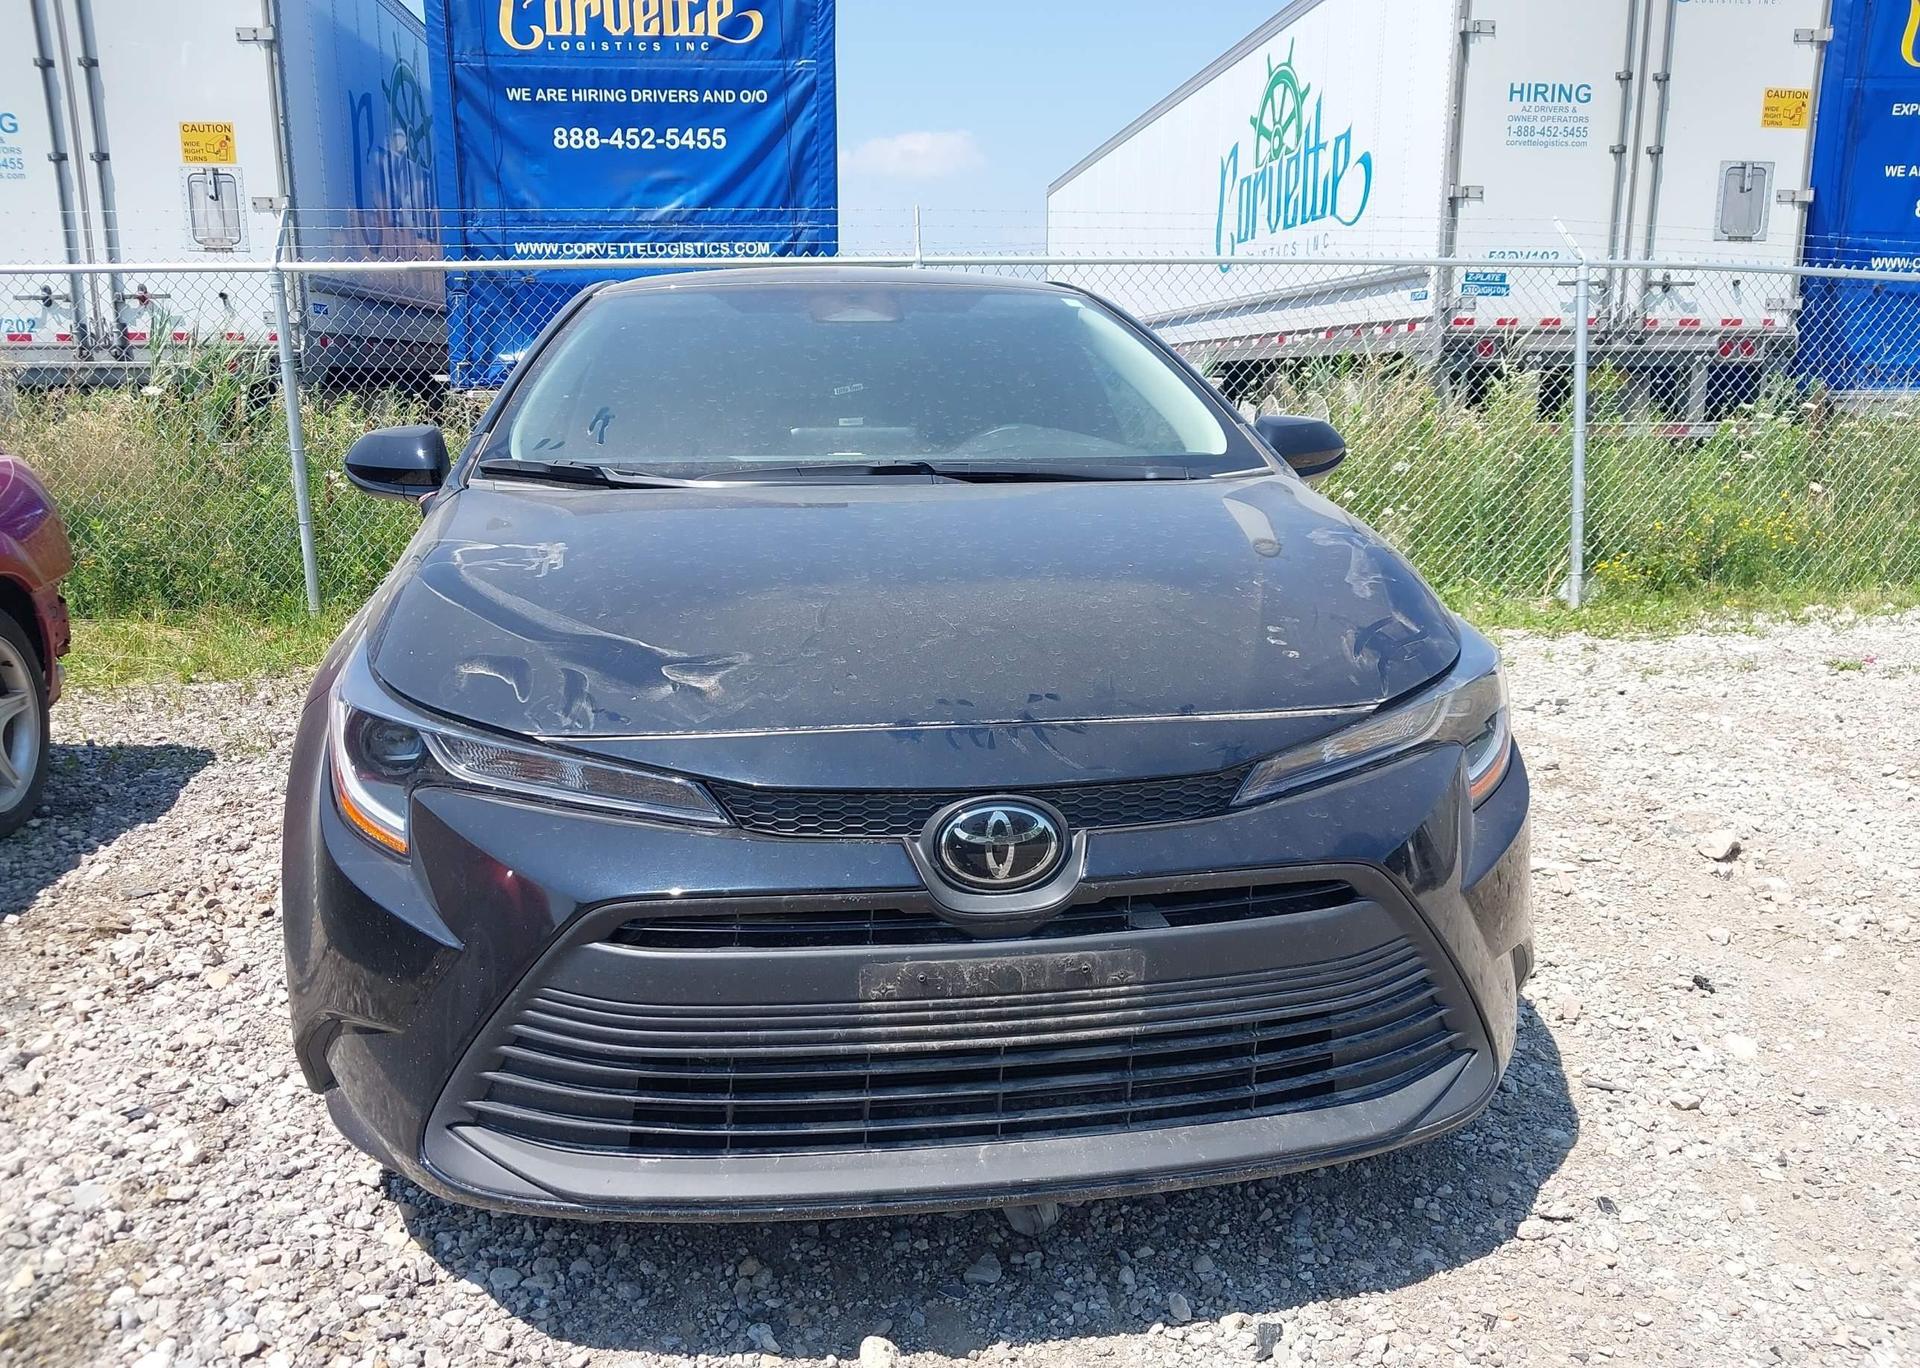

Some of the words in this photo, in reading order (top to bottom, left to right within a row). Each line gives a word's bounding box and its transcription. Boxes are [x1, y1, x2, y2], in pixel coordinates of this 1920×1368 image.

[547, 41, 662, 51] LOGISTICS
[676, 42, 711, 51] INC
[506, 88, 532, 101] WE
[535, 88, 568, 102] ARE
[571, 89, 628, 102] HIRING
[631, 89, 699, 103] DRIVERS
[702, 90, 737, 103] AND
[739, 89, 768, 103] O/O
[1509, 82, 1592, 103] HIRING
[1766, 89, 1809, 99] CAUTION
[1521, 105, 1533, 113] AZ
[1534, 105, 1570, 114] DRIVERS
[1571, 106, 1578, 114] &
[1892, 103, 1920, 116] EXP
[1507, 115, 1538, 123] OWNER
[1540, 115, 1590, 124] OPERATORS
[182, 124, 232, 133] CAUTION
[1506, 125, 1589, 138] 1-888-452-5455
[553, 127, 727, 150] 888-452-5455
[1505, 139, 1588, 149] corvettelogistics.com
[1884, 165, 1906, 177] WE
[1215, 90, 1373, 273] Corvette
[514, 242, 770, 255] WWW.CORVETTELOGISTICS.COM
[1466, 273, 1502, 281] Z-PLATE
